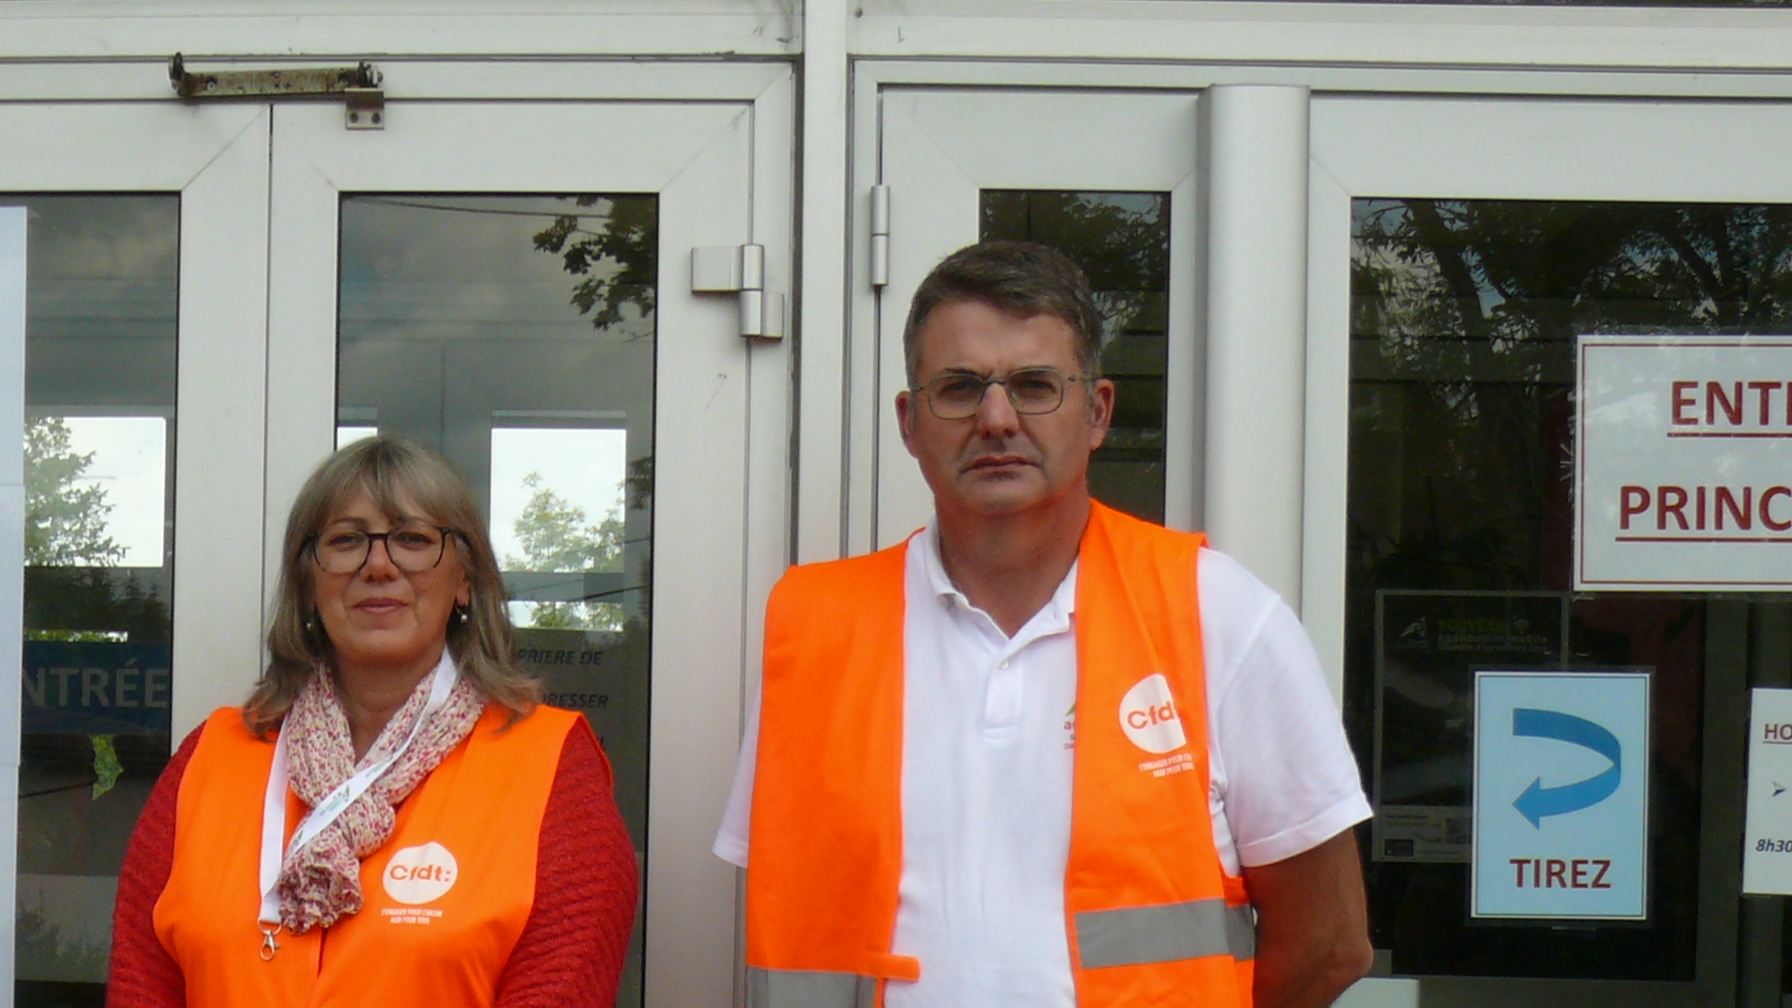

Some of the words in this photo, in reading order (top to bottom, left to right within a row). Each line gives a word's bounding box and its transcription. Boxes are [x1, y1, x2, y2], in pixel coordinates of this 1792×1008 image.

[1671, 381, 1792, 426] ENT
[1620, 485, 1792, 531] PRINC
[579, 650, 604, 666] DE
[22, 657, 169, 709] NTRÉE
[543, 692, 609, 709] RESSER
[389, 863, 452, 882] Cfdt:
[1509, 858, 1612, 889] TIREZ
